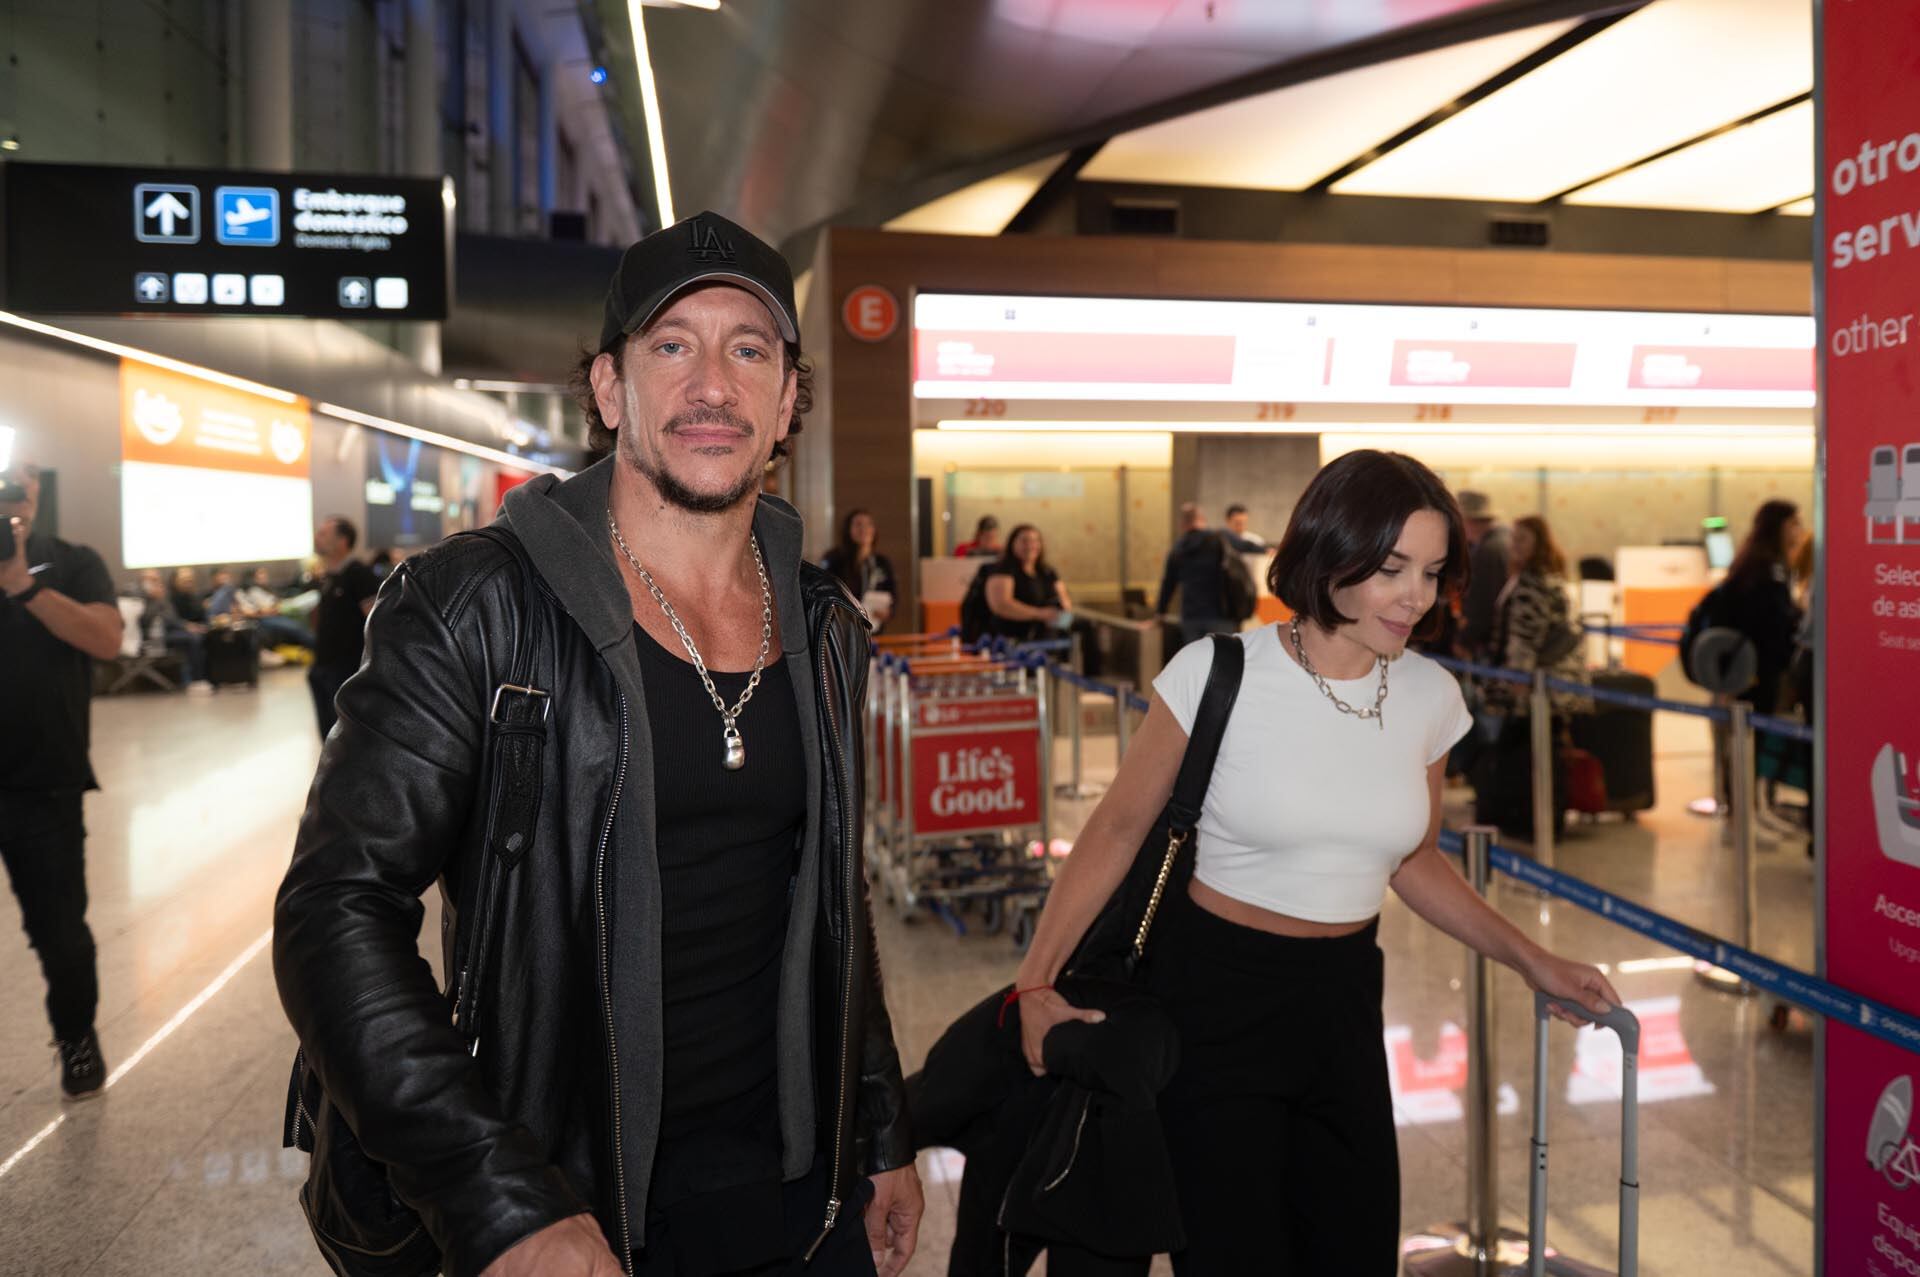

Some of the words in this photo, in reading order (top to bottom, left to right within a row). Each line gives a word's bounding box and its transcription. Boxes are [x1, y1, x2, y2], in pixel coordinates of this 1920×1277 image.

[294, 188, 406, 214] Embarque
[687, 219, 737, 264] LA
[859, 295, 882, 331] E
[1832, 313, 1914, 357] other
[1872, 595, 1895, 617] de
[937, 746, 1014, 783] Life's
[930, 777, 1026, 818] Good.
